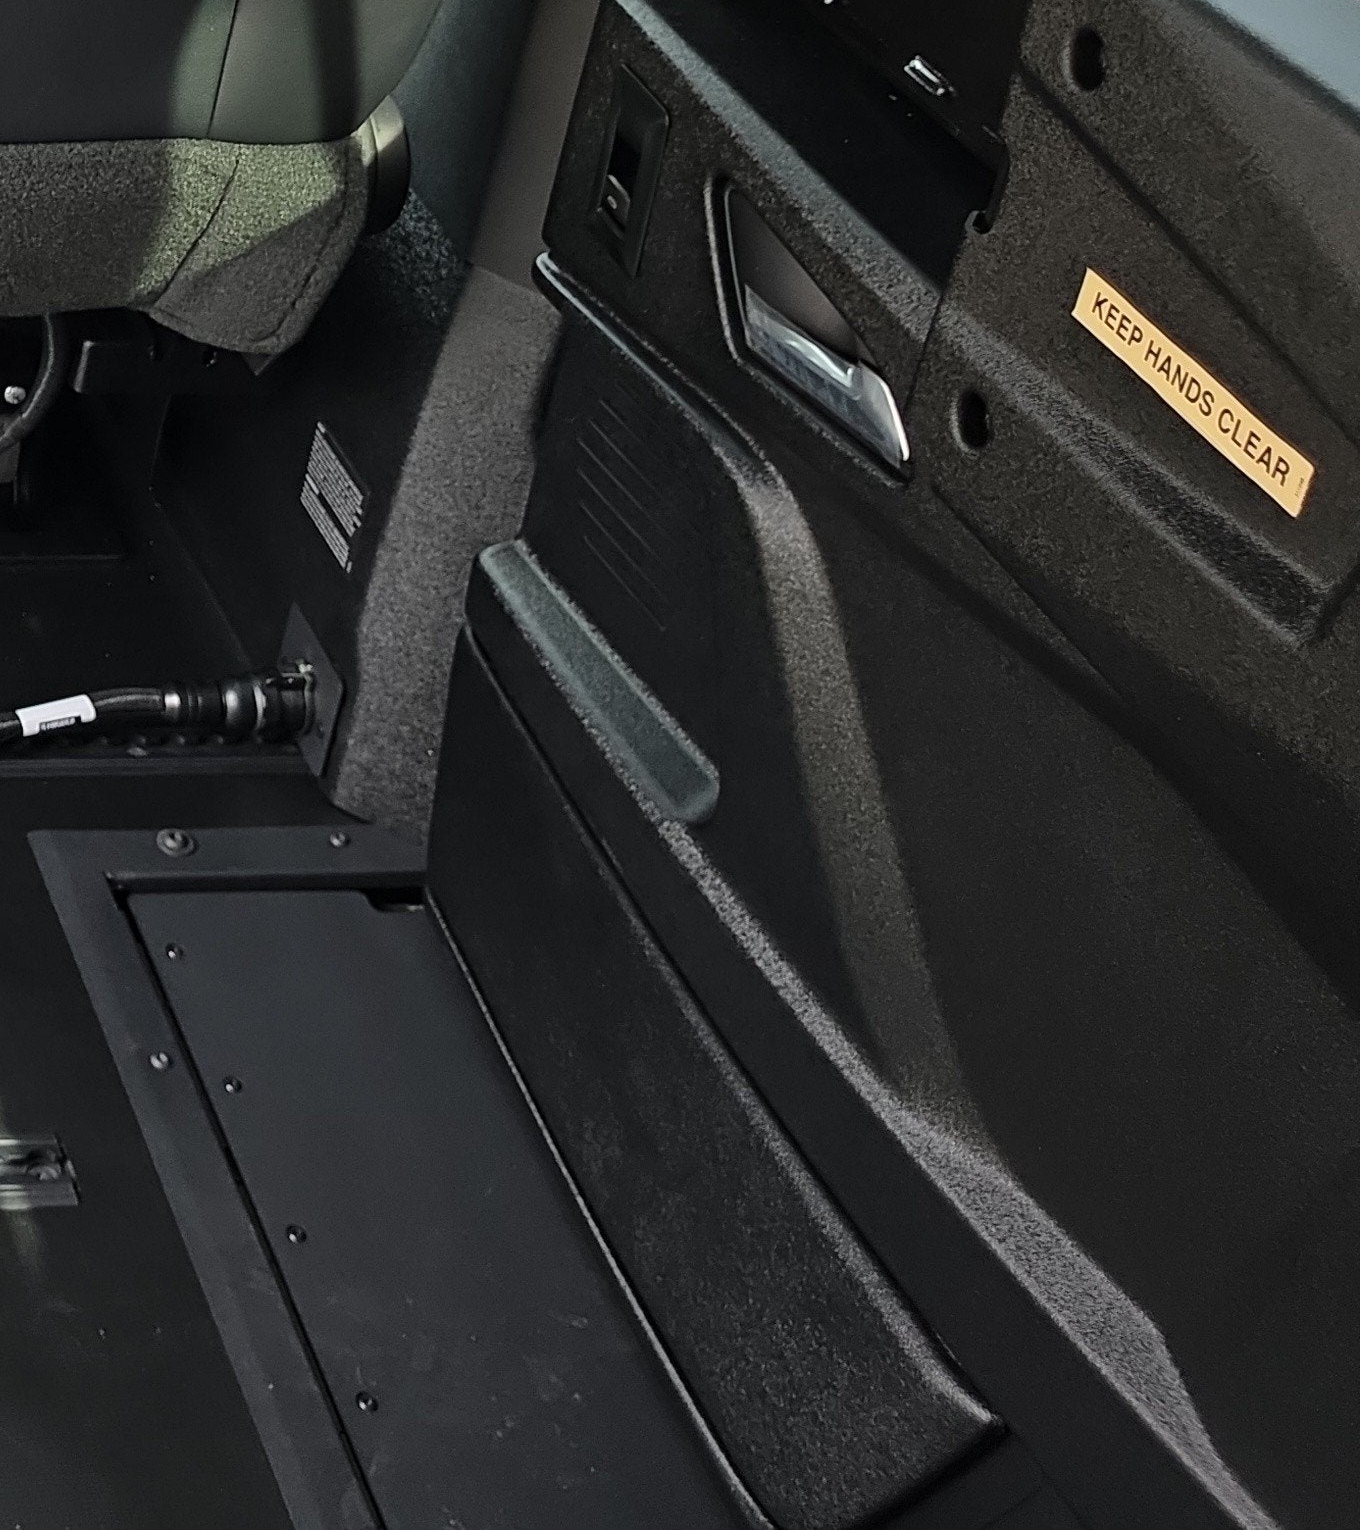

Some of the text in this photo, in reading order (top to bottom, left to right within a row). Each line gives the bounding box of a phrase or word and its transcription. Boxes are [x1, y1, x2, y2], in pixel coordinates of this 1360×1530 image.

[1091, 291, 1291, 487] KEEP HANDS CLEAR
